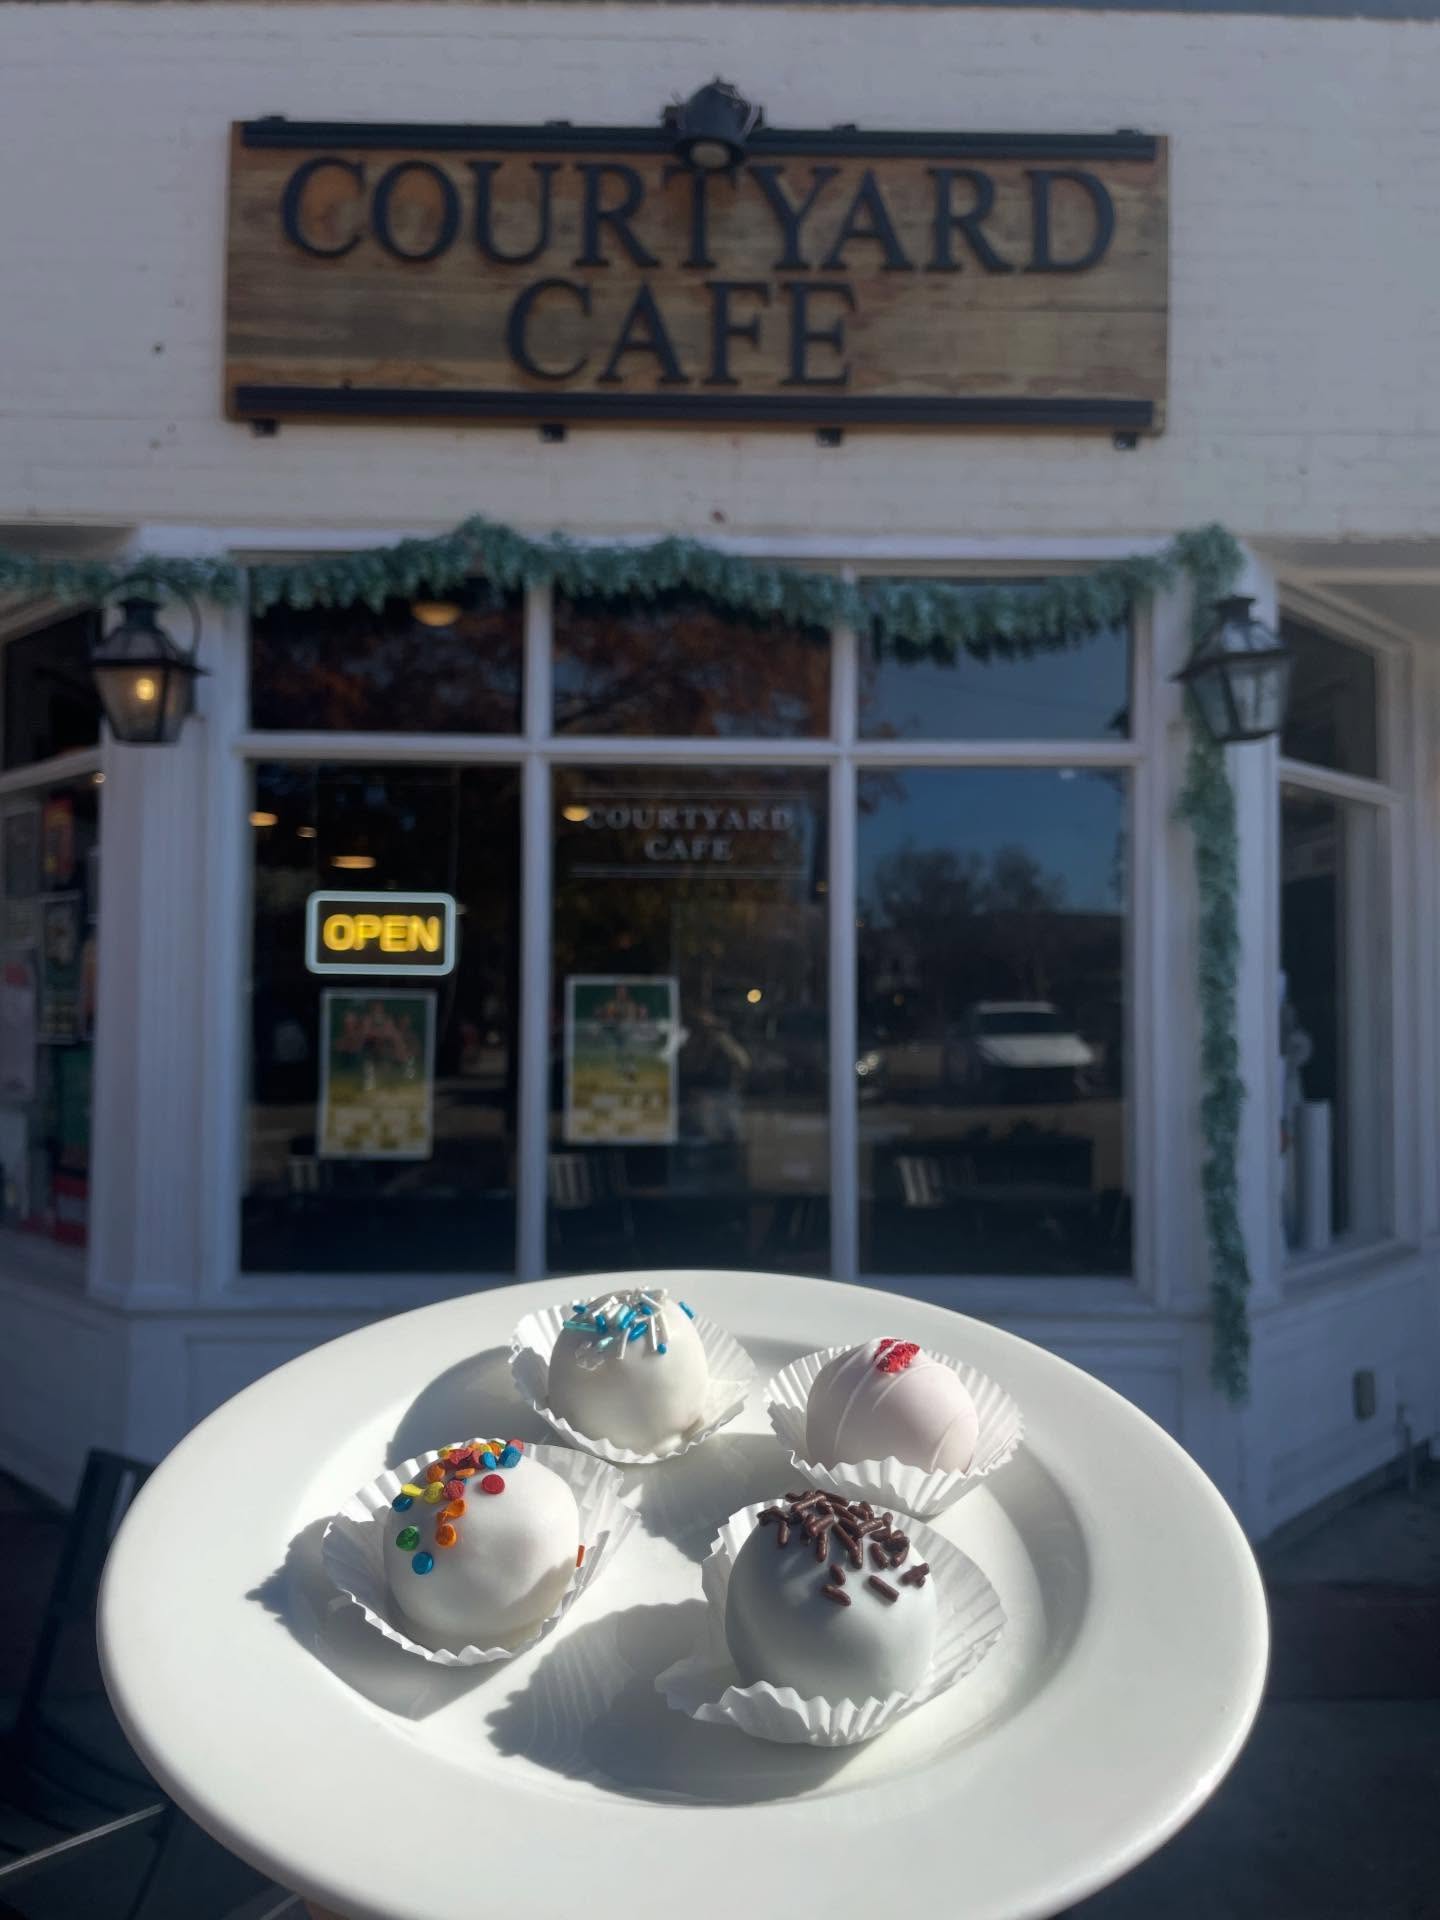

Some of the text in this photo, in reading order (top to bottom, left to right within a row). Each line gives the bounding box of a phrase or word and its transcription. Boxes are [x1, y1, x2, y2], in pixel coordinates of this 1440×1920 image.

[280, 154, 1114, 272] COURTYARD
[505, 277, 856, 388] CAFE
[585, 804, 794, 831] COURTYARD
[645, 836, 733, 861] CAFE
[322, 913, 441, 953] OPEN
